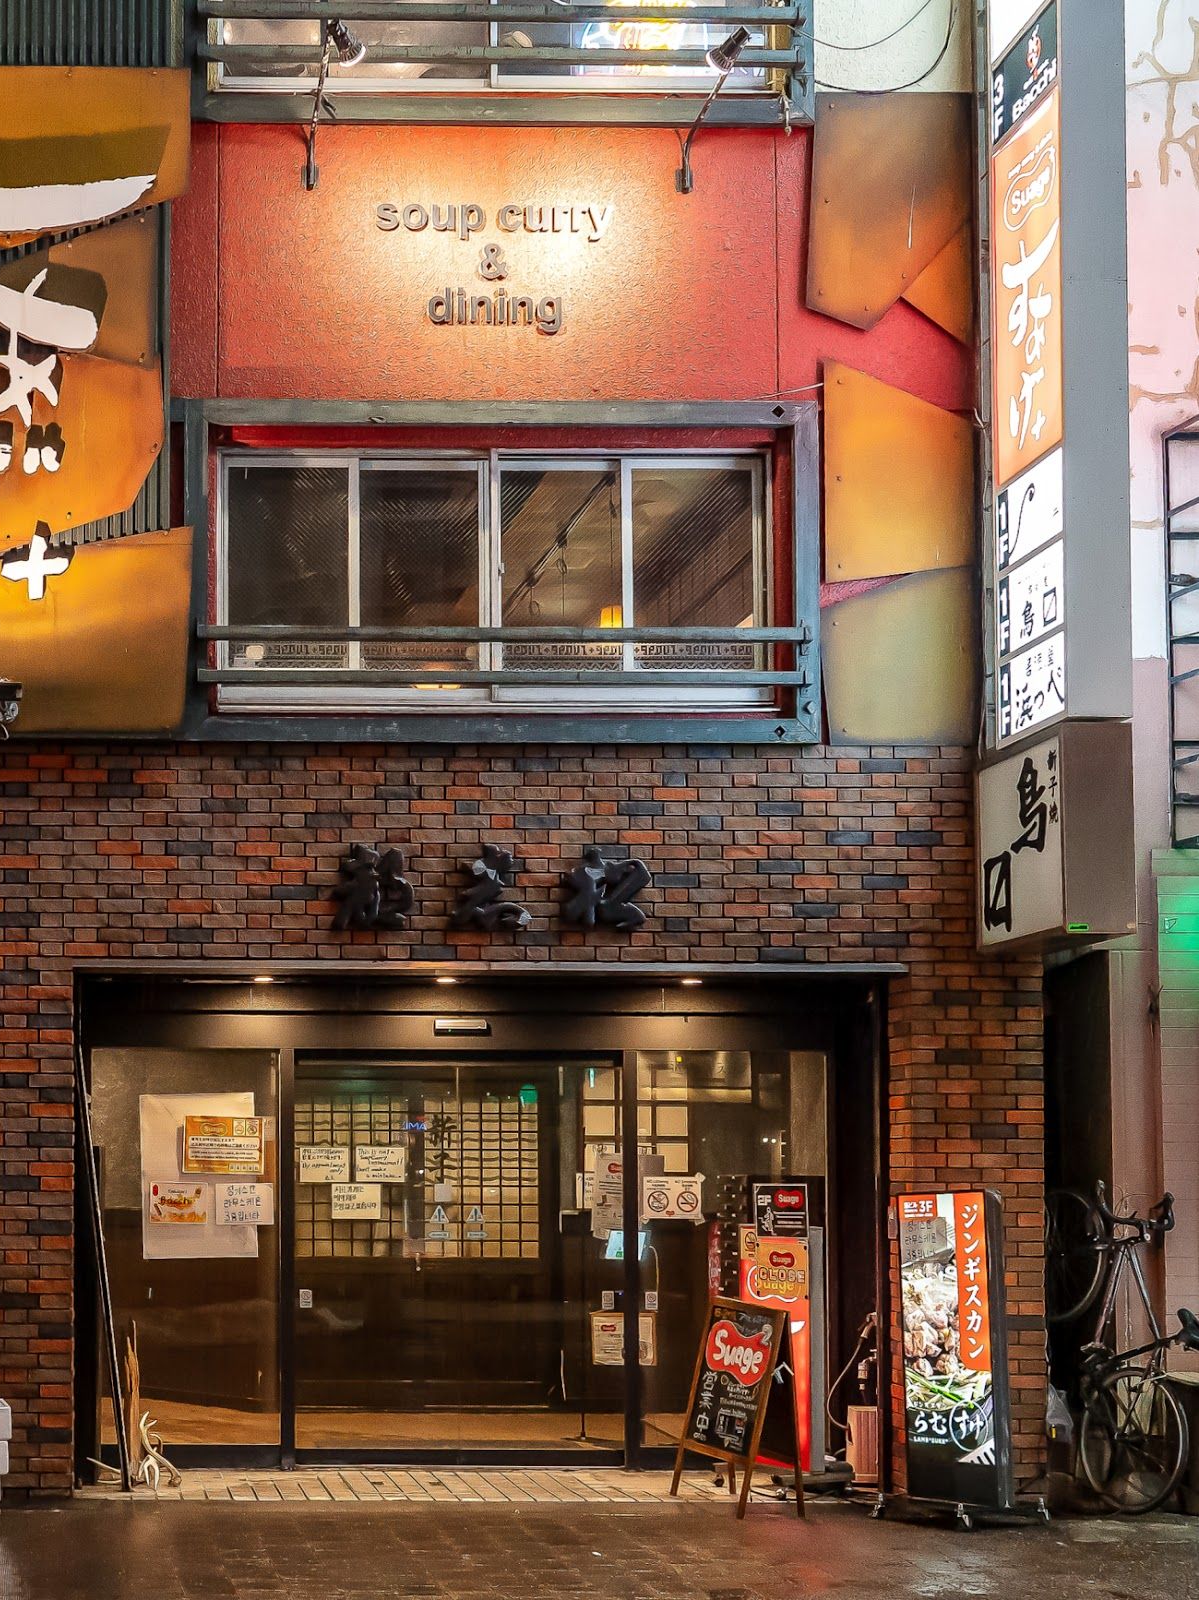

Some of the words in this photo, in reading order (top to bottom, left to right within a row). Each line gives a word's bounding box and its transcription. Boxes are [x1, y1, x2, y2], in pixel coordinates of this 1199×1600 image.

[375, 201, 486, 241] soup
[497, 201, 614, 242] curry
[479, 243, 509, 280] &
[427, 286, 563, 335] dining
[759, 1266, 806, 1284] CLOSE
[961, 1203, 985, 1359] ジンギスカン
[712, 1329, 764, 1375] Suage
